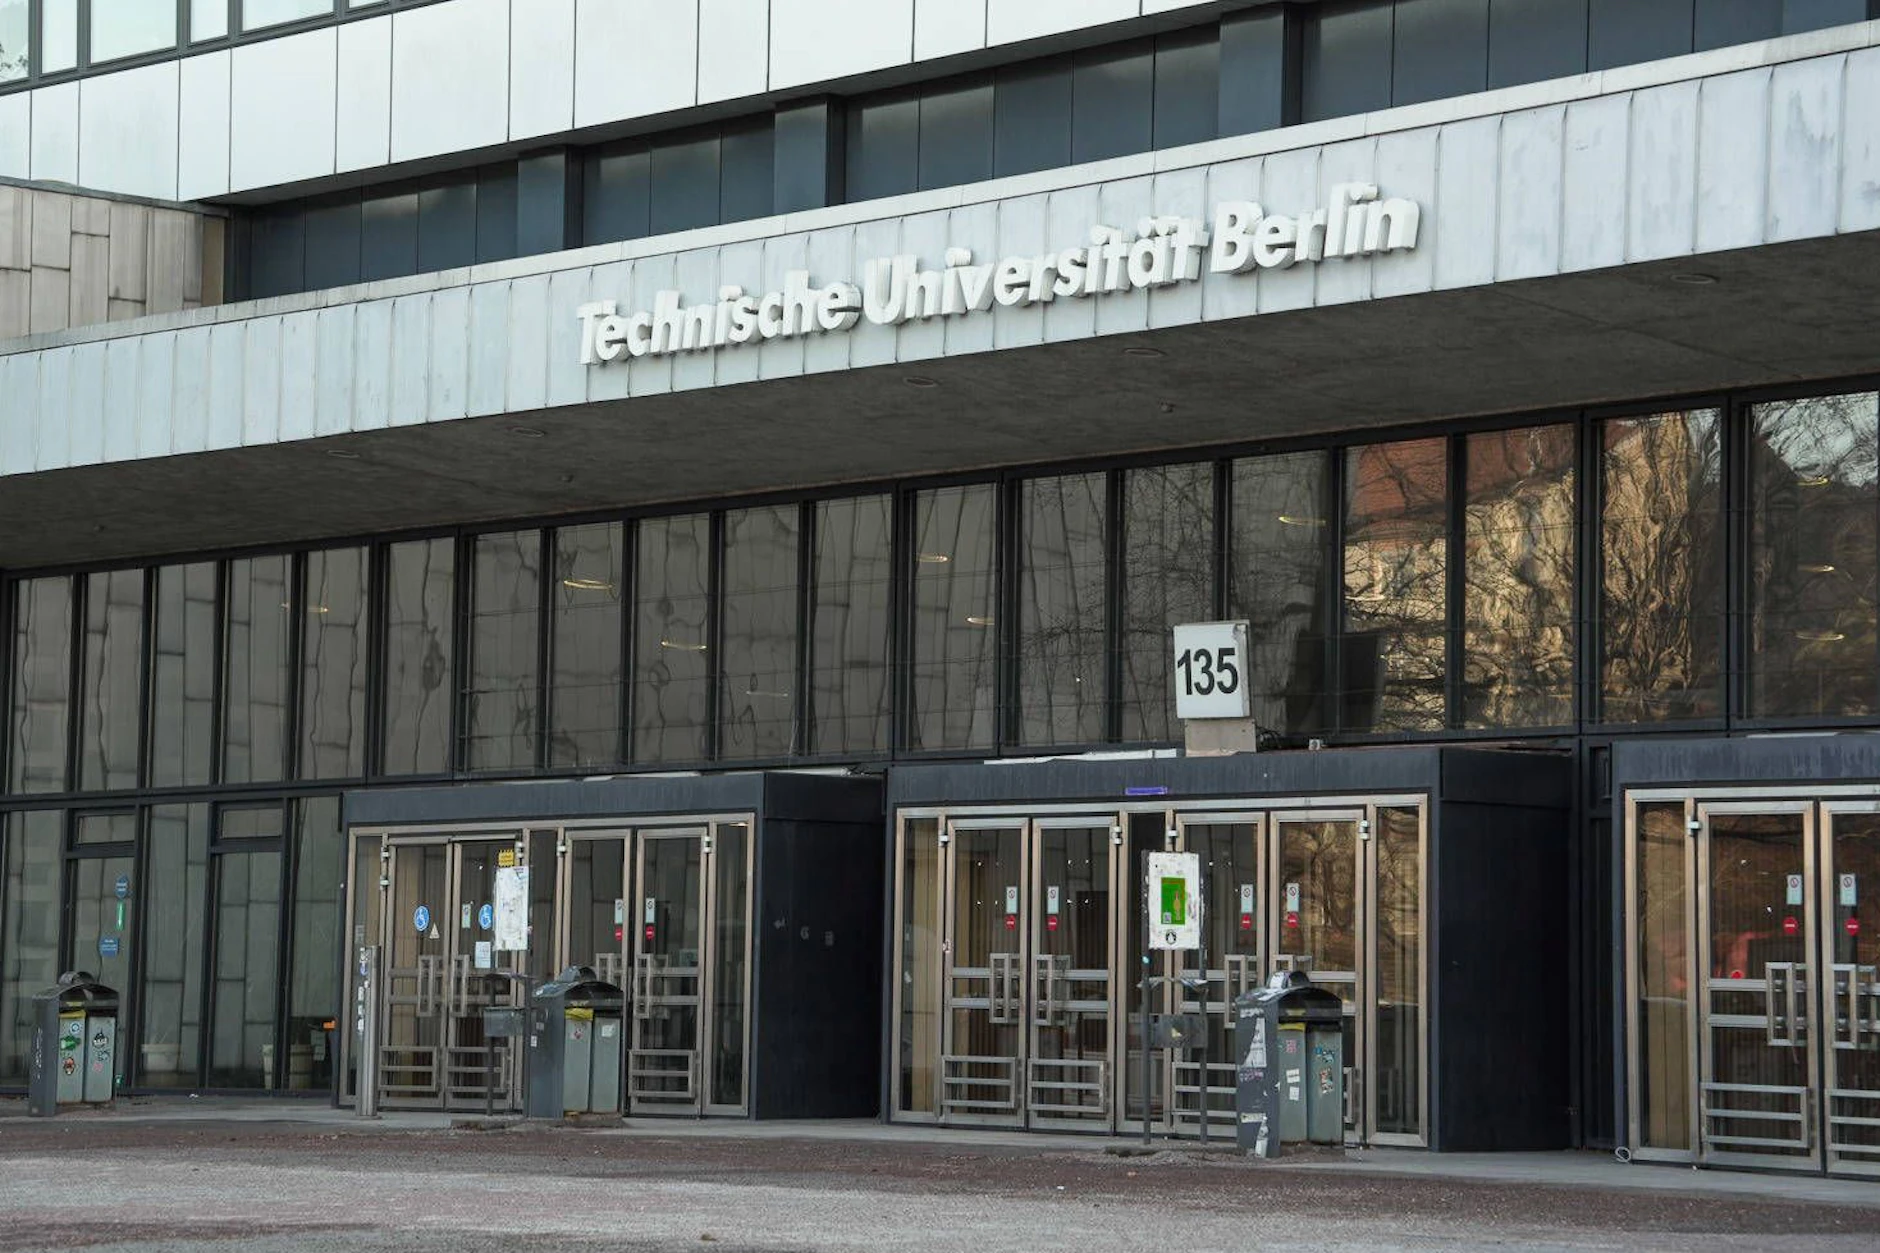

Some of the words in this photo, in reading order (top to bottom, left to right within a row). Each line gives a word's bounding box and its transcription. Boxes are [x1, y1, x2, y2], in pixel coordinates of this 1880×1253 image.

[578, 269, 862, 365] Technische
[864, 216, 1209, 325] Universität
[1210, 182, 1420, 275] Berlin
[1177, 647, 1239, 695] 135
